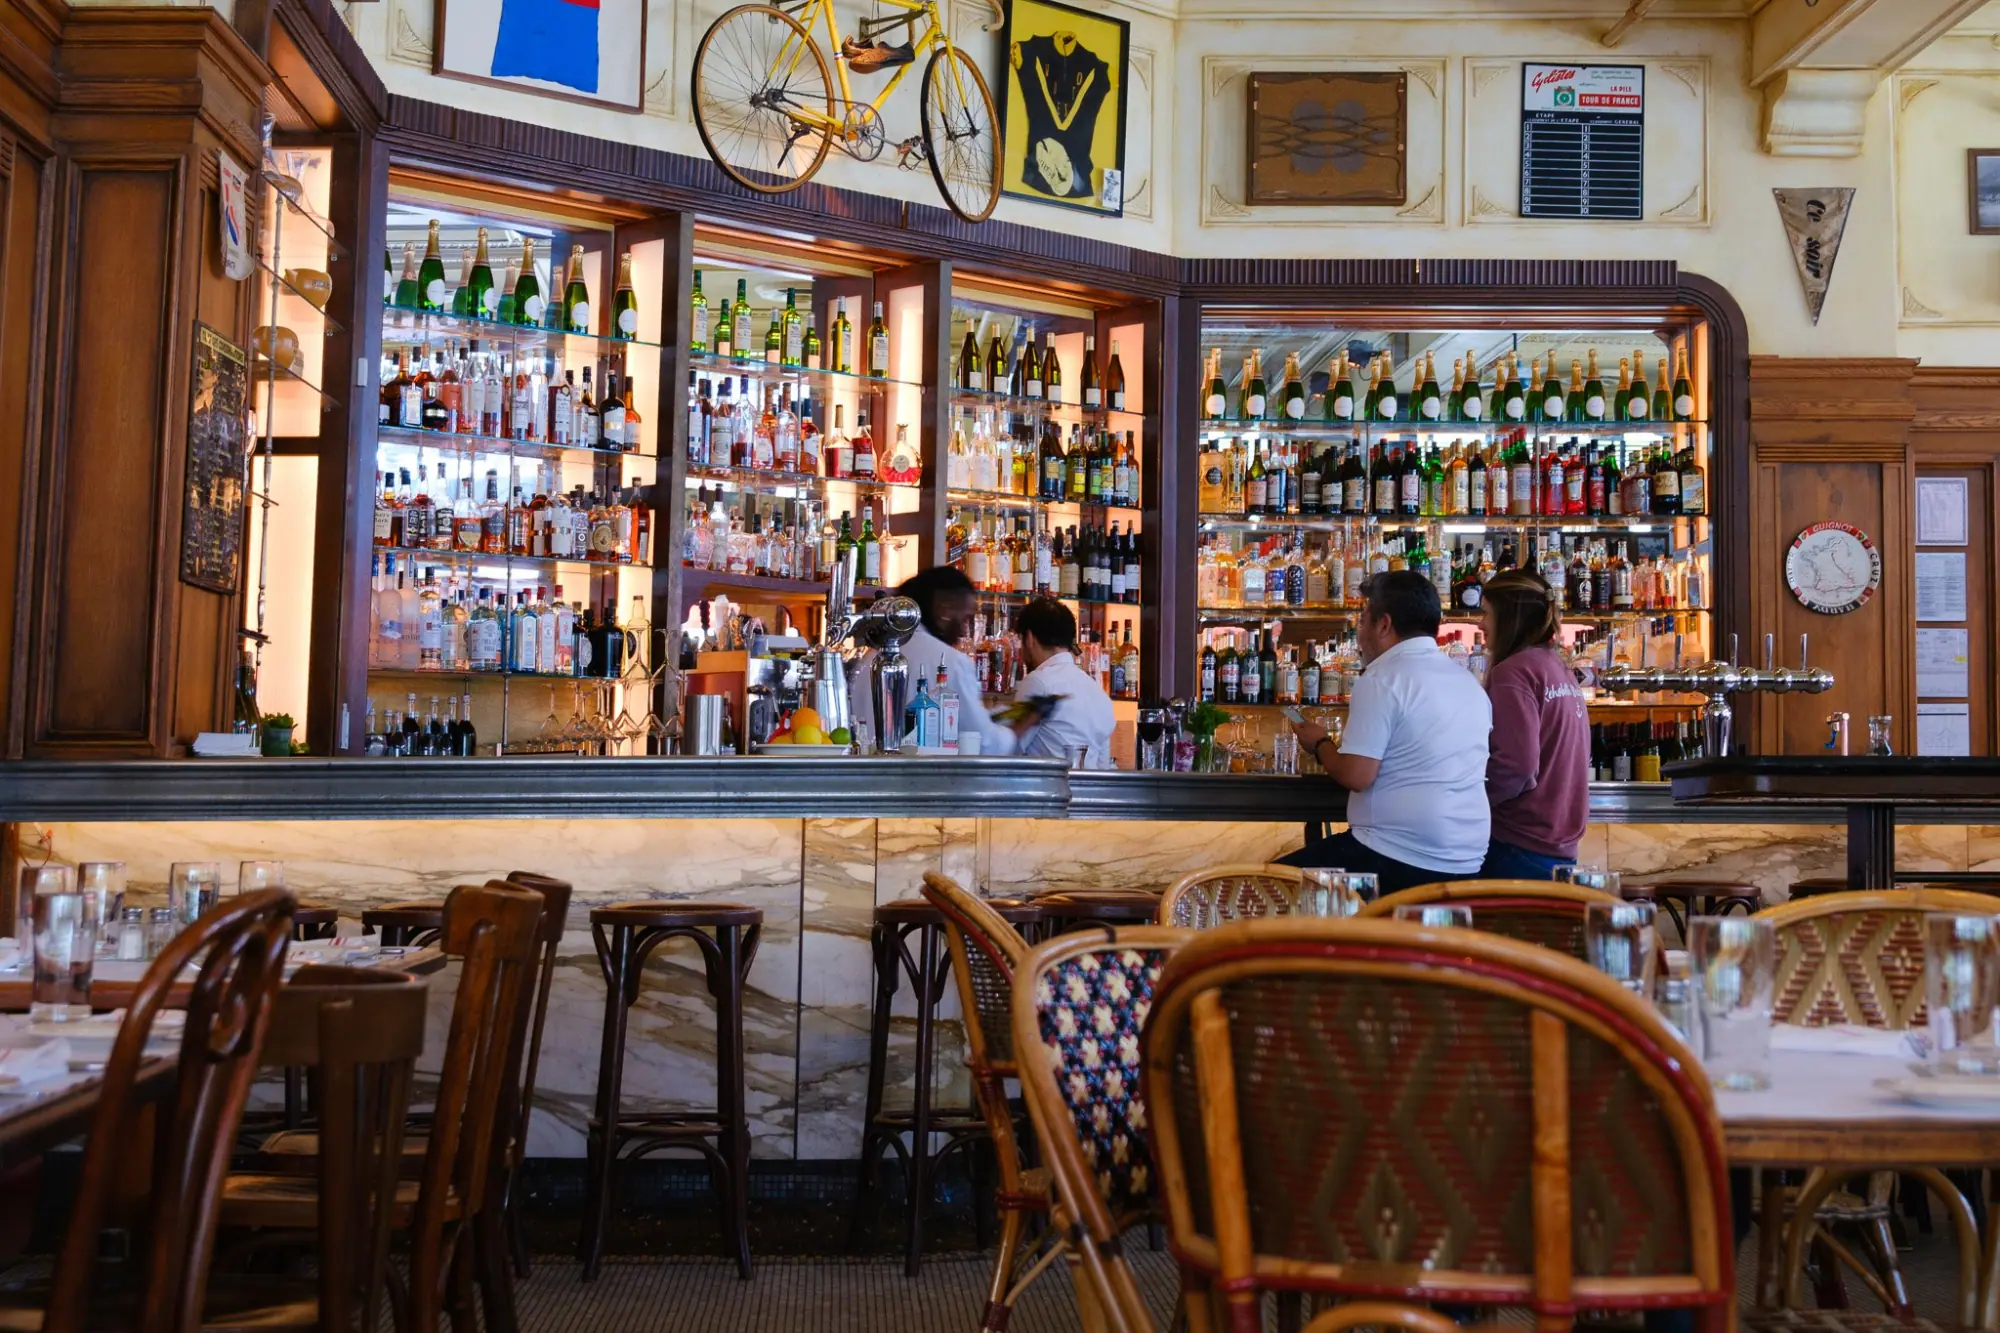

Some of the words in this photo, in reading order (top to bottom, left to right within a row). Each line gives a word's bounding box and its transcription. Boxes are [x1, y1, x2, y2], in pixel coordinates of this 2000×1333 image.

[1582, 96, 1599, 104] TOUR
[1601, 96, 1610, 104] DE
[1612, 97, 1639, 105] FRANCE
[1806, 200, 1826, 222] Ce
[1806, 237, 1824, 279] soir
[1870, 553, 1879, 583] CRUZ
[1812, 603, 1855, 614] HARDY
